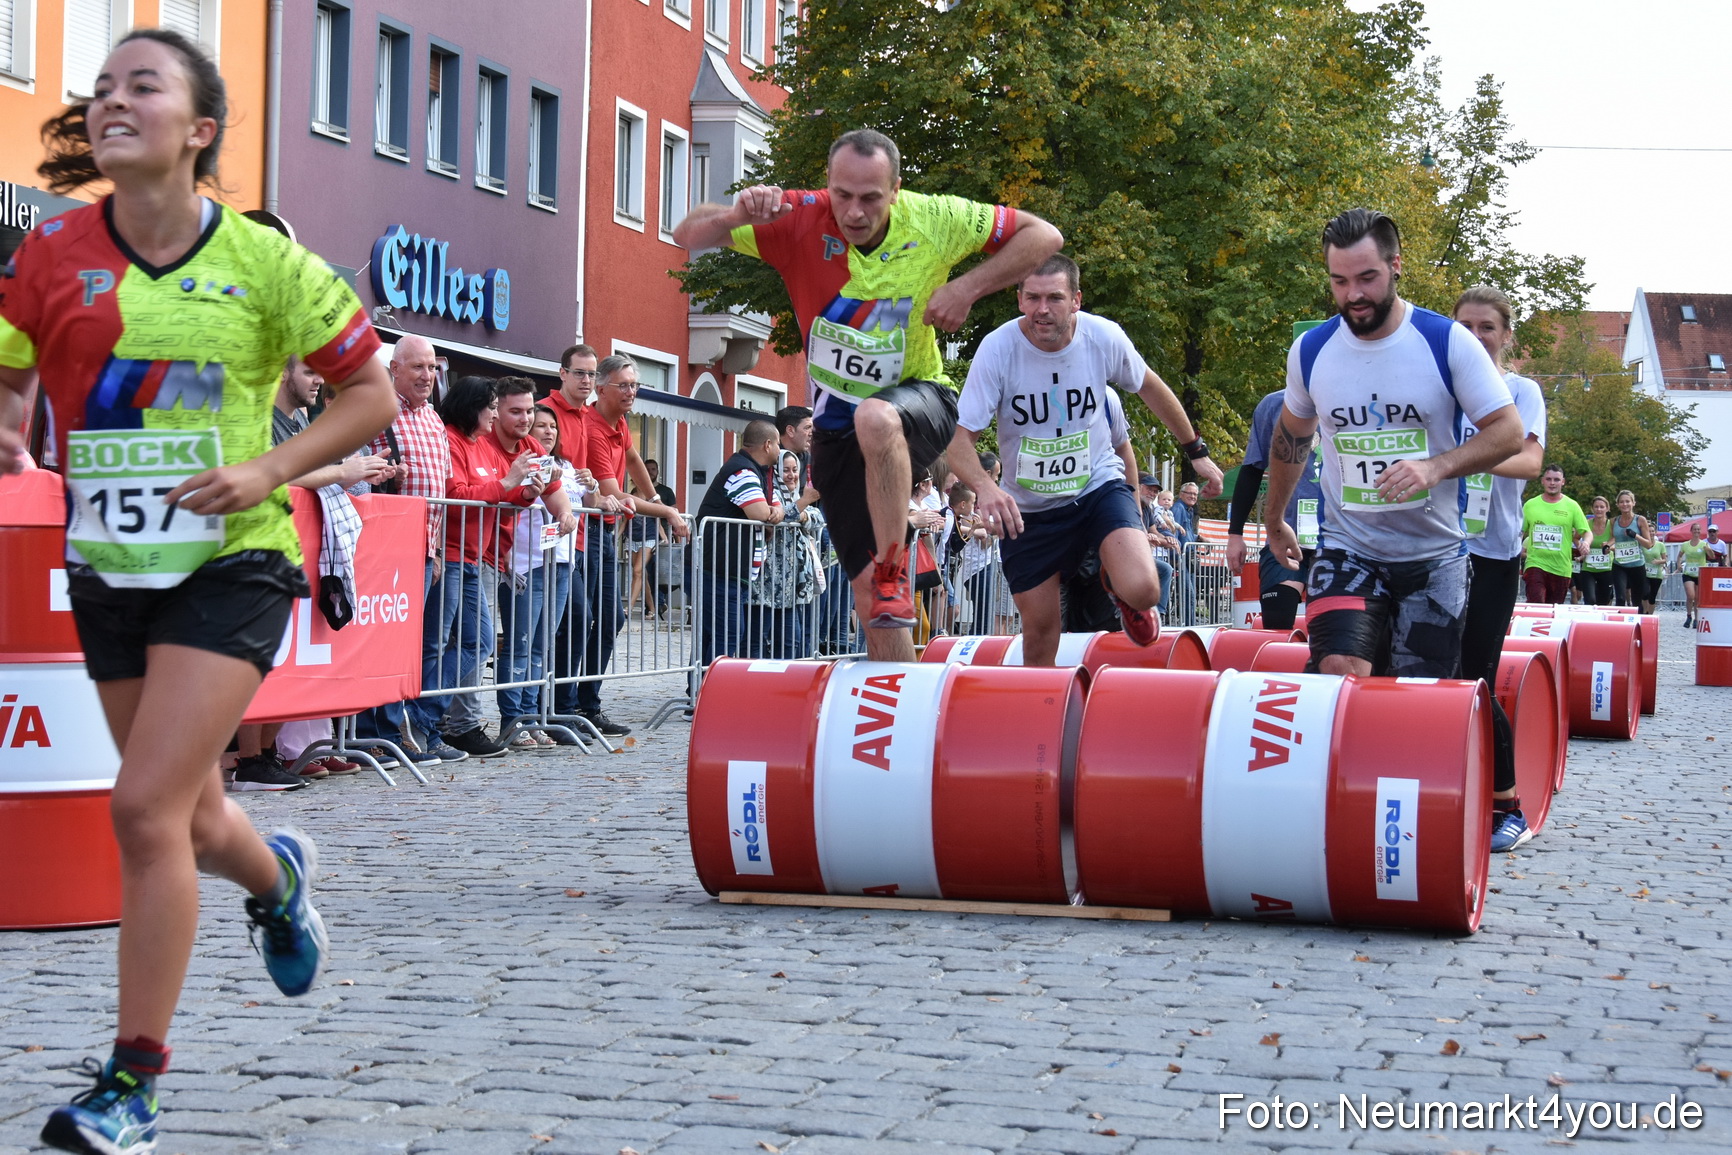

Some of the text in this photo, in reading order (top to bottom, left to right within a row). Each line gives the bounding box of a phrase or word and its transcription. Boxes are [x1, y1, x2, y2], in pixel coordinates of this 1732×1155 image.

[0, 182, 40, 230] ller
[381, 224, 486, 325] Eilles
[818, 322, 896, 352] BOCK
[831, 348, 882, 382] 164
[1011, 386, 1097, 426] SUSPA
[1330, 401, 1423, 428] SUSPA
[69, 438, 205, 471] BOCK
[1026, 435, 1085, 453] BOCK
[1338, 433, 1418, 452] BOCK
[1034, 456, 1077, 478] 140
[1356, 459, 1406, 483] 13
[1029, 480, 1078, 491] JOHANN
[90, 487, 180, 534] 157
[1304, 503, 1317, 513] B
[1540, 533, 1555, 541] 144
